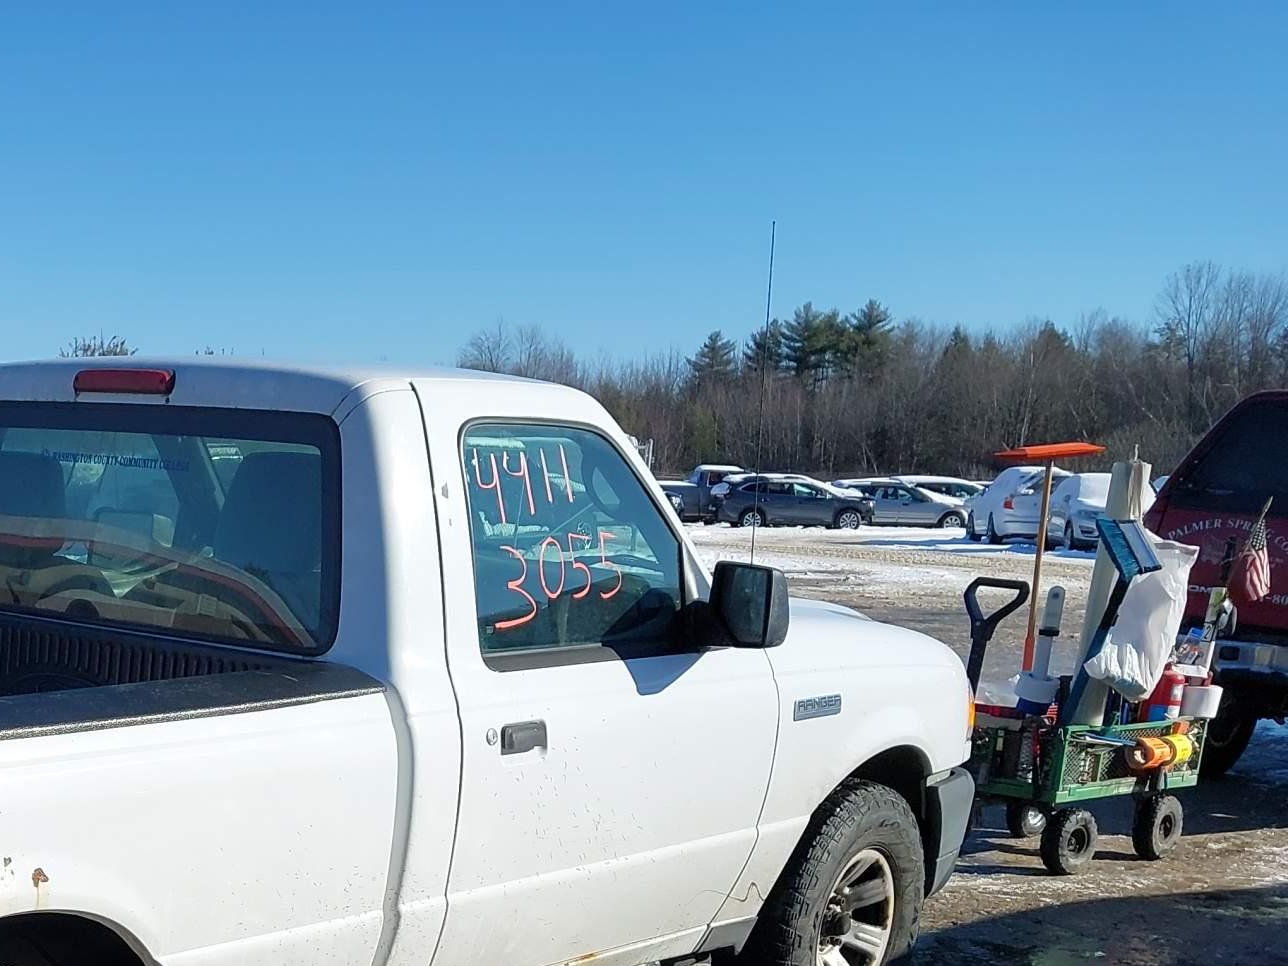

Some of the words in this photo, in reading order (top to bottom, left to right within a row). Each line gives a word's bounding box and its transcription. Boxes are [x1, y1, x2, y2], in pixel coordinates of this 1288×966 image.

[473, 444, 574, 523] 4411
[1168, 519, 1222, 540] PALMER
[495, 531, 622, 629] 3055
[798, 695, 841, 711] RANGER
